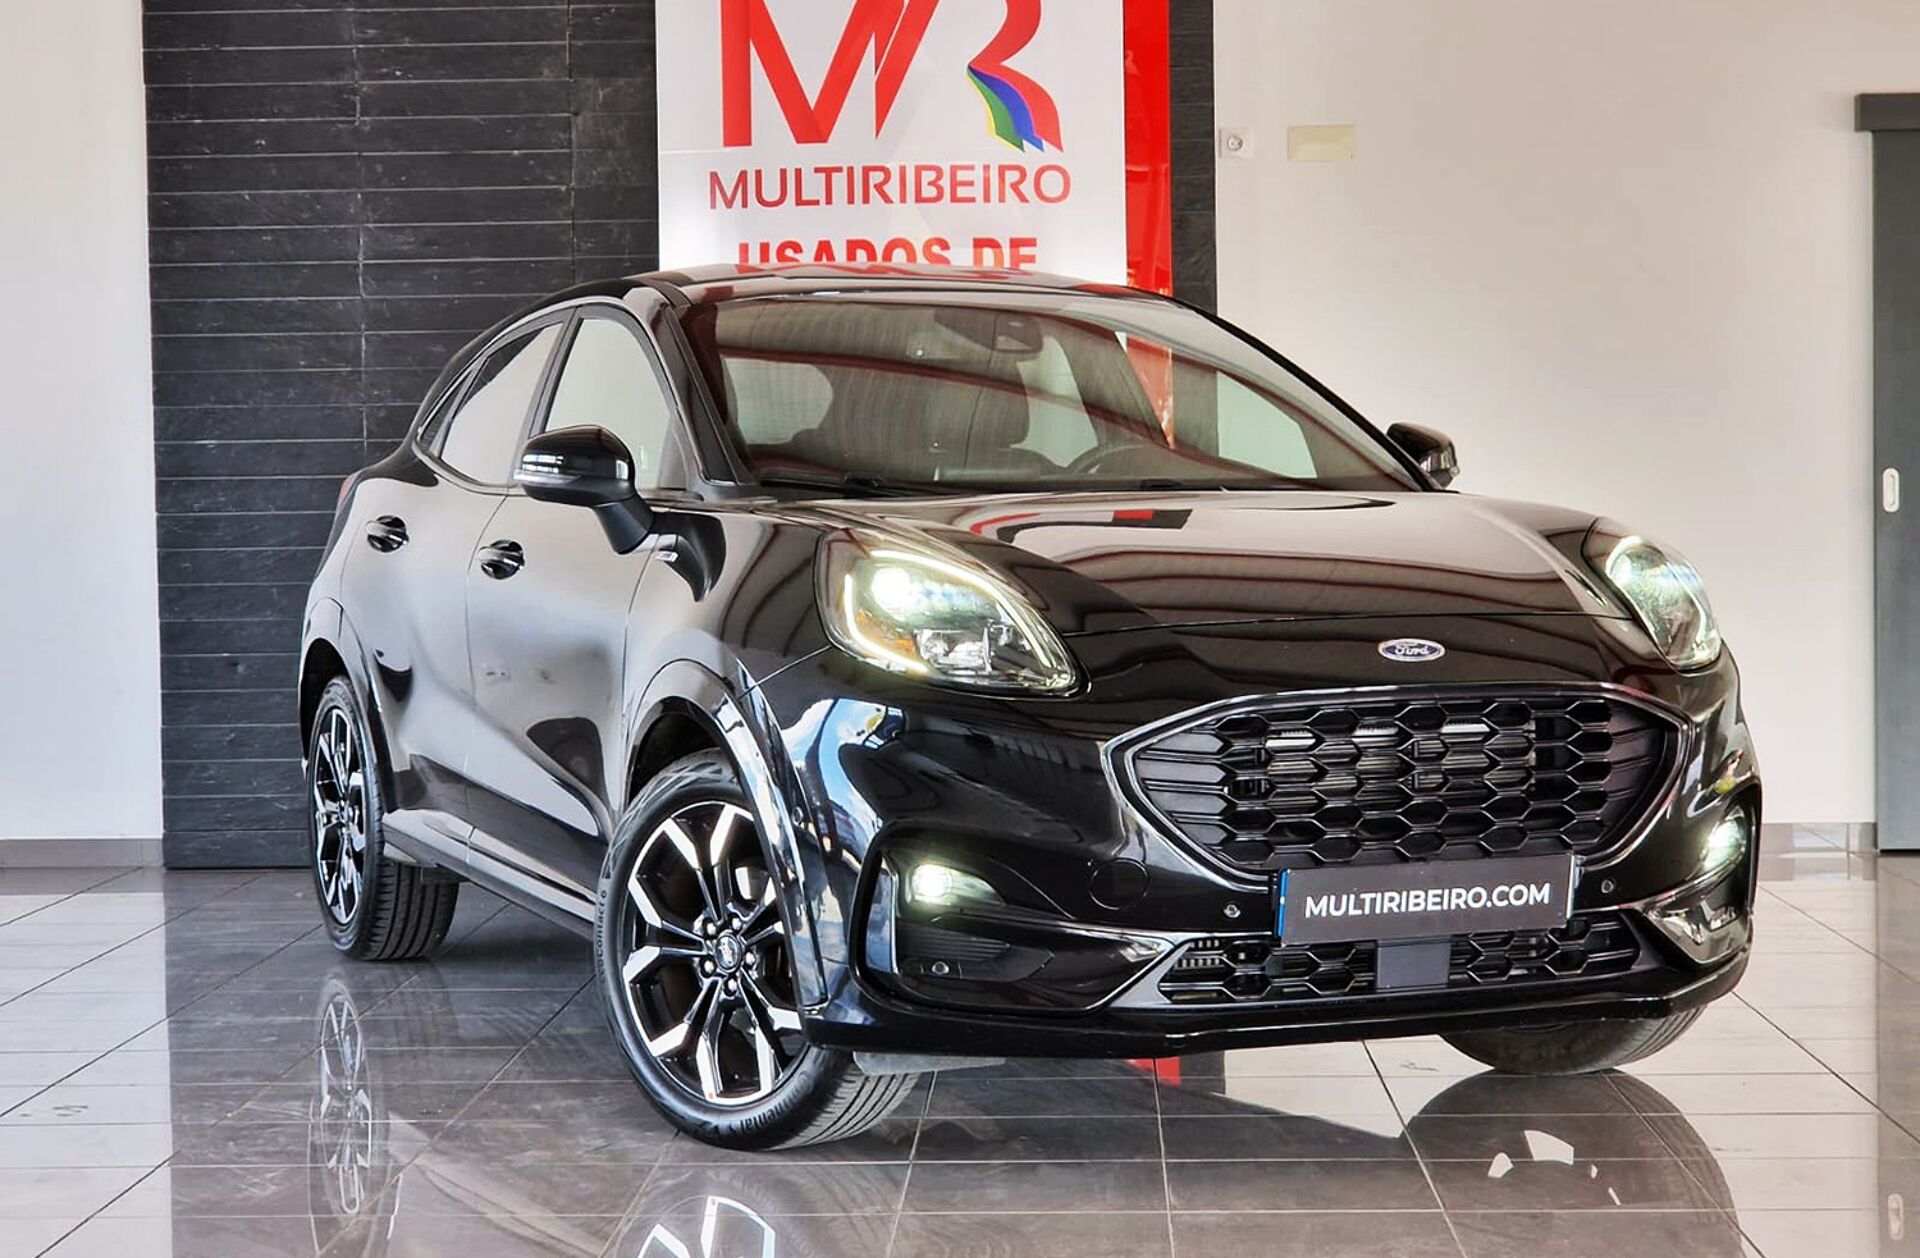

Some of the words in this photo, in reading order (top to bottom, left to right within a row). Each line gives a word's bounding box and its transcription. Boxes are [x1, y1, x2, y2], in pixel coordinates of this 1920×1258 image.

[709, 164, 1072, 210] MULTIRIBEIRO
[972, 237, 1037, 269] DE
[1305, 882, 1550, 918] MULTIRIBEIRO.COM
